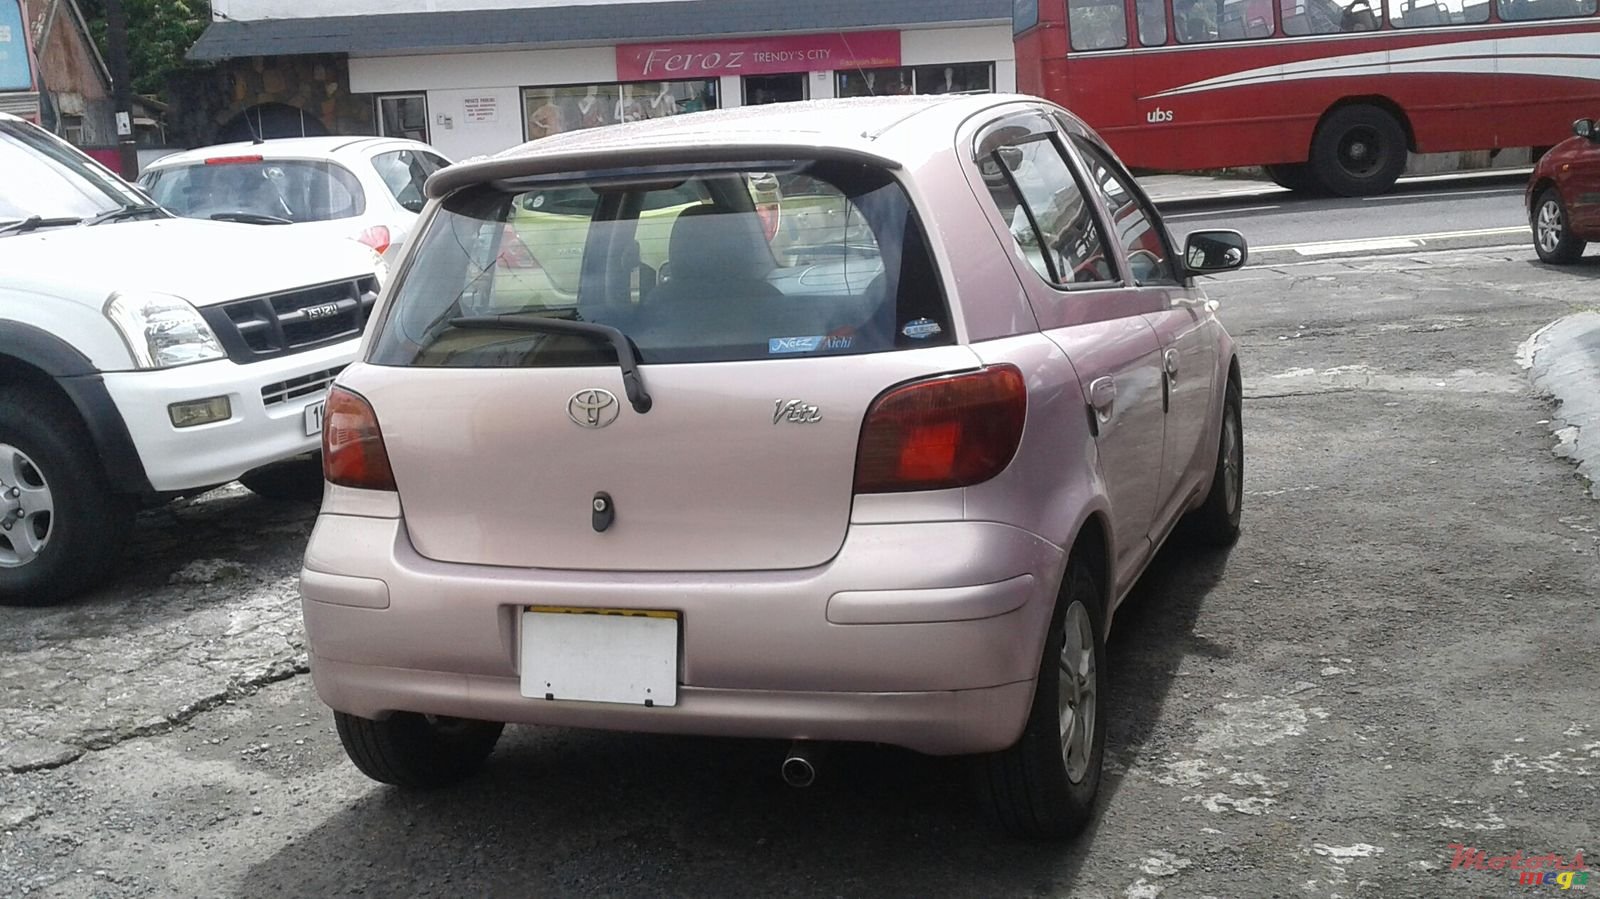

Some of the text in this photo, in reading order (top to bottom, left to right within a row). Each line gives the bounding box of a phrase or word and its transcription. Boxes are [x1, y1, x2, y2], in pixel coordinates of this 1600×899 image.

[753, 50, 804, 63] TRENDY'S
[807, 48, 831, 60] CITY
[1147, 106, 1174, 123] ubs
[308, 304, 337, 319] ISUZU
[773, 398, 823, 424] Vitz
